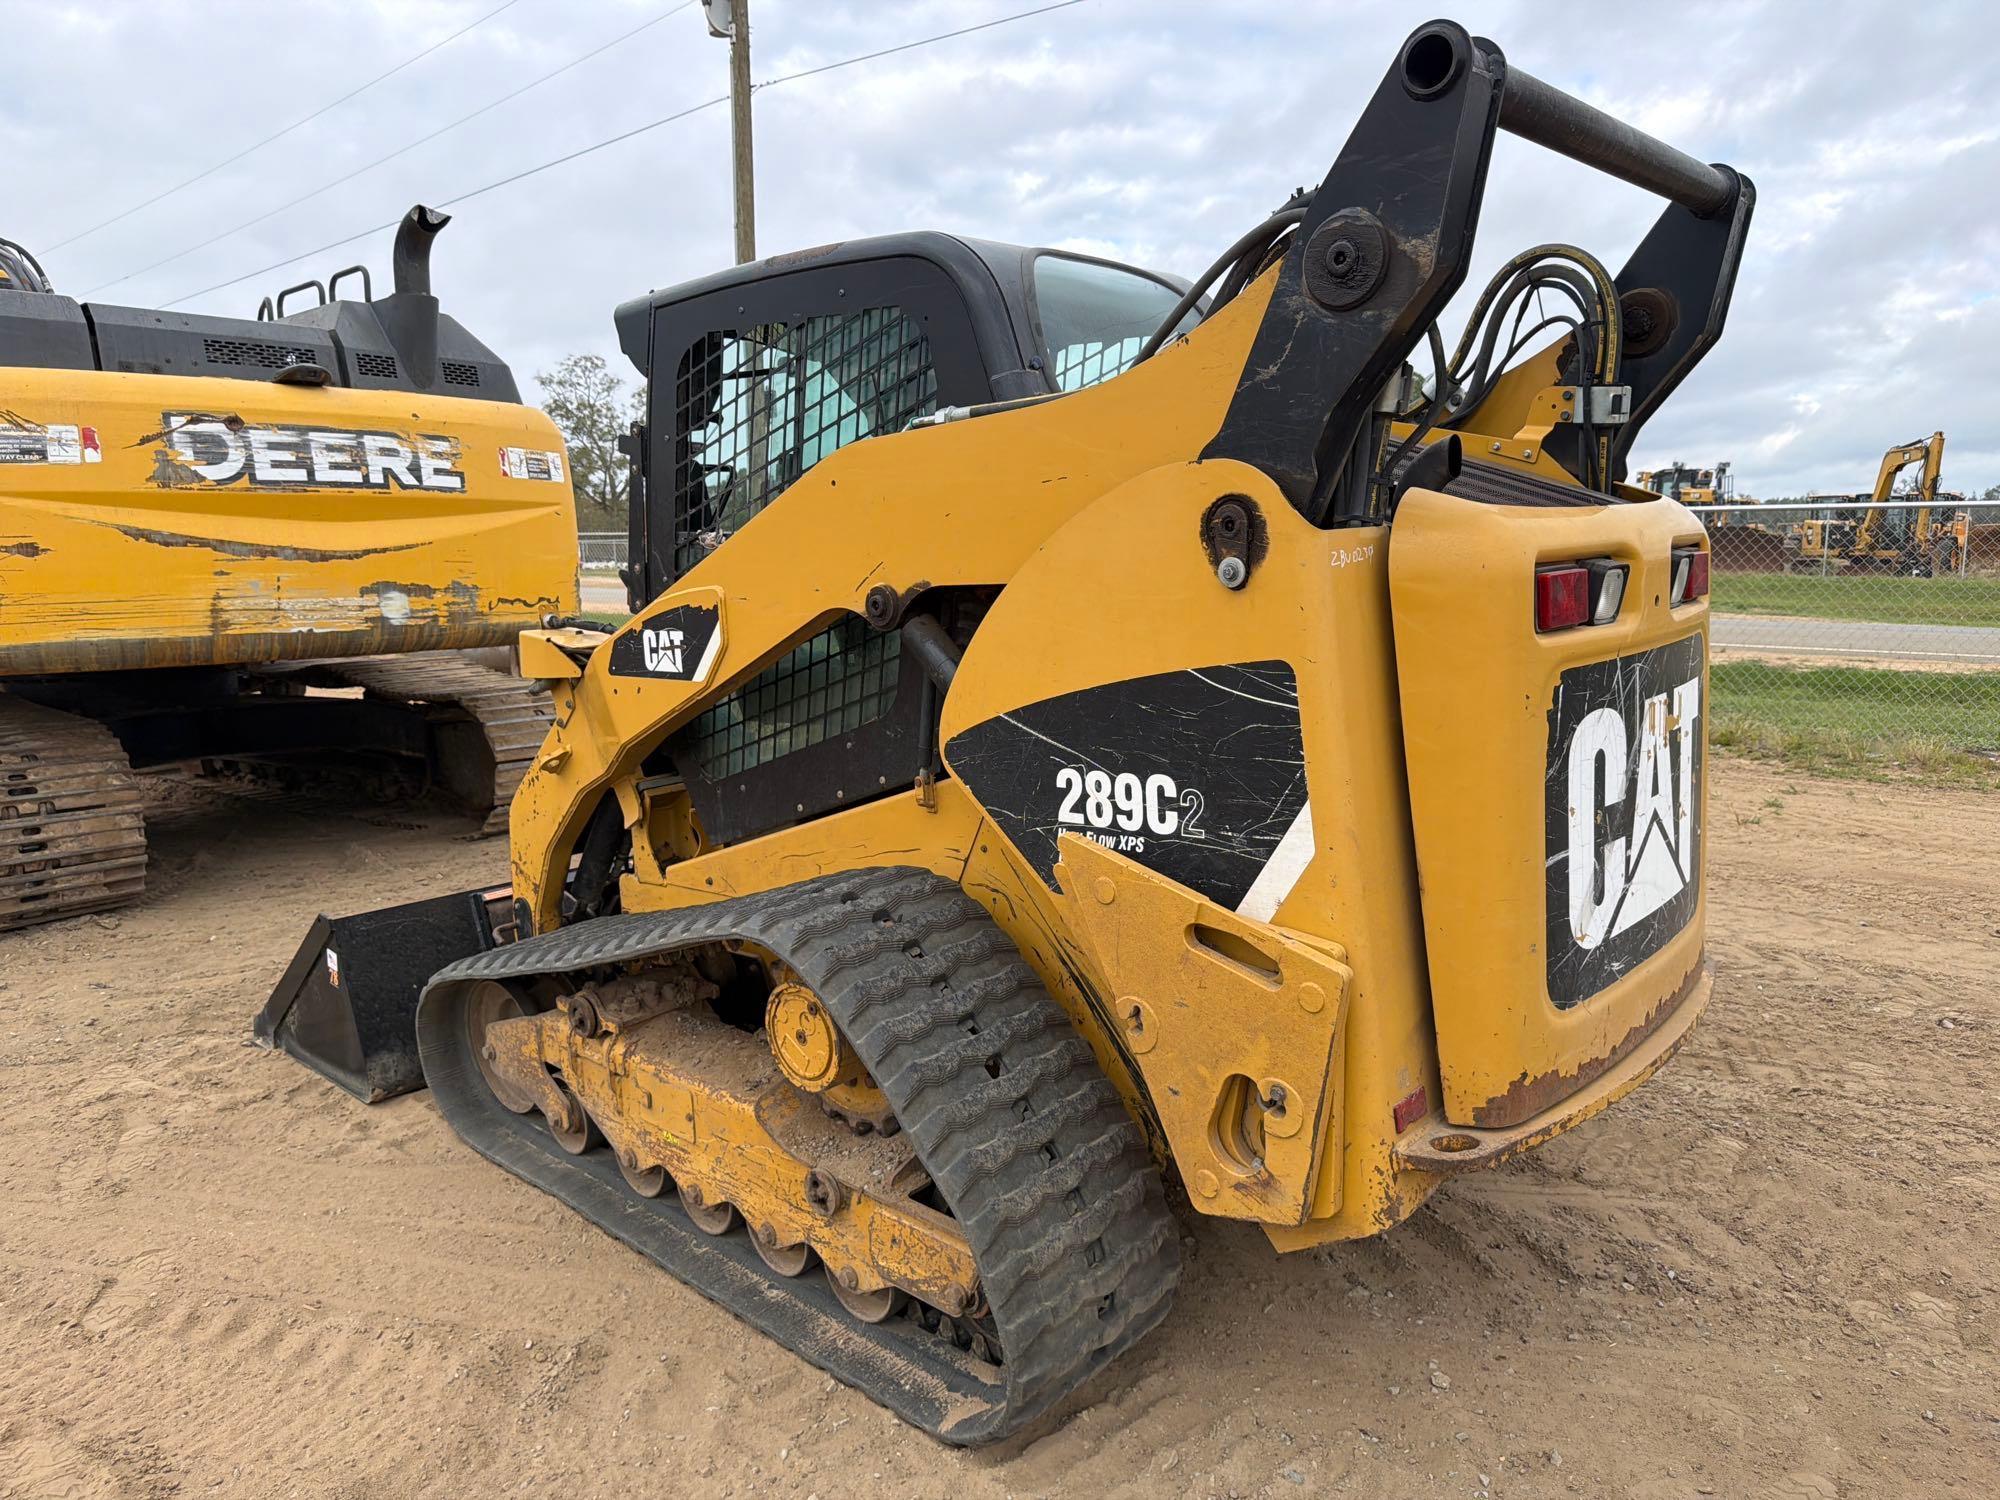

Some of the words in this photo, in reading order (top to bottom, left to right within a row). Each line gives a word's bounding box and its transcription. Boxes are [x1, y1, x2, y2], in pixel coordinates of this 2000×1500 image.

[164, 412, 464, 490] DEERE
[643, 629, 684, 673] CAT
[1568, 676, 1699, 950] CAT
[1118, 835, 1146, 853] XPS
